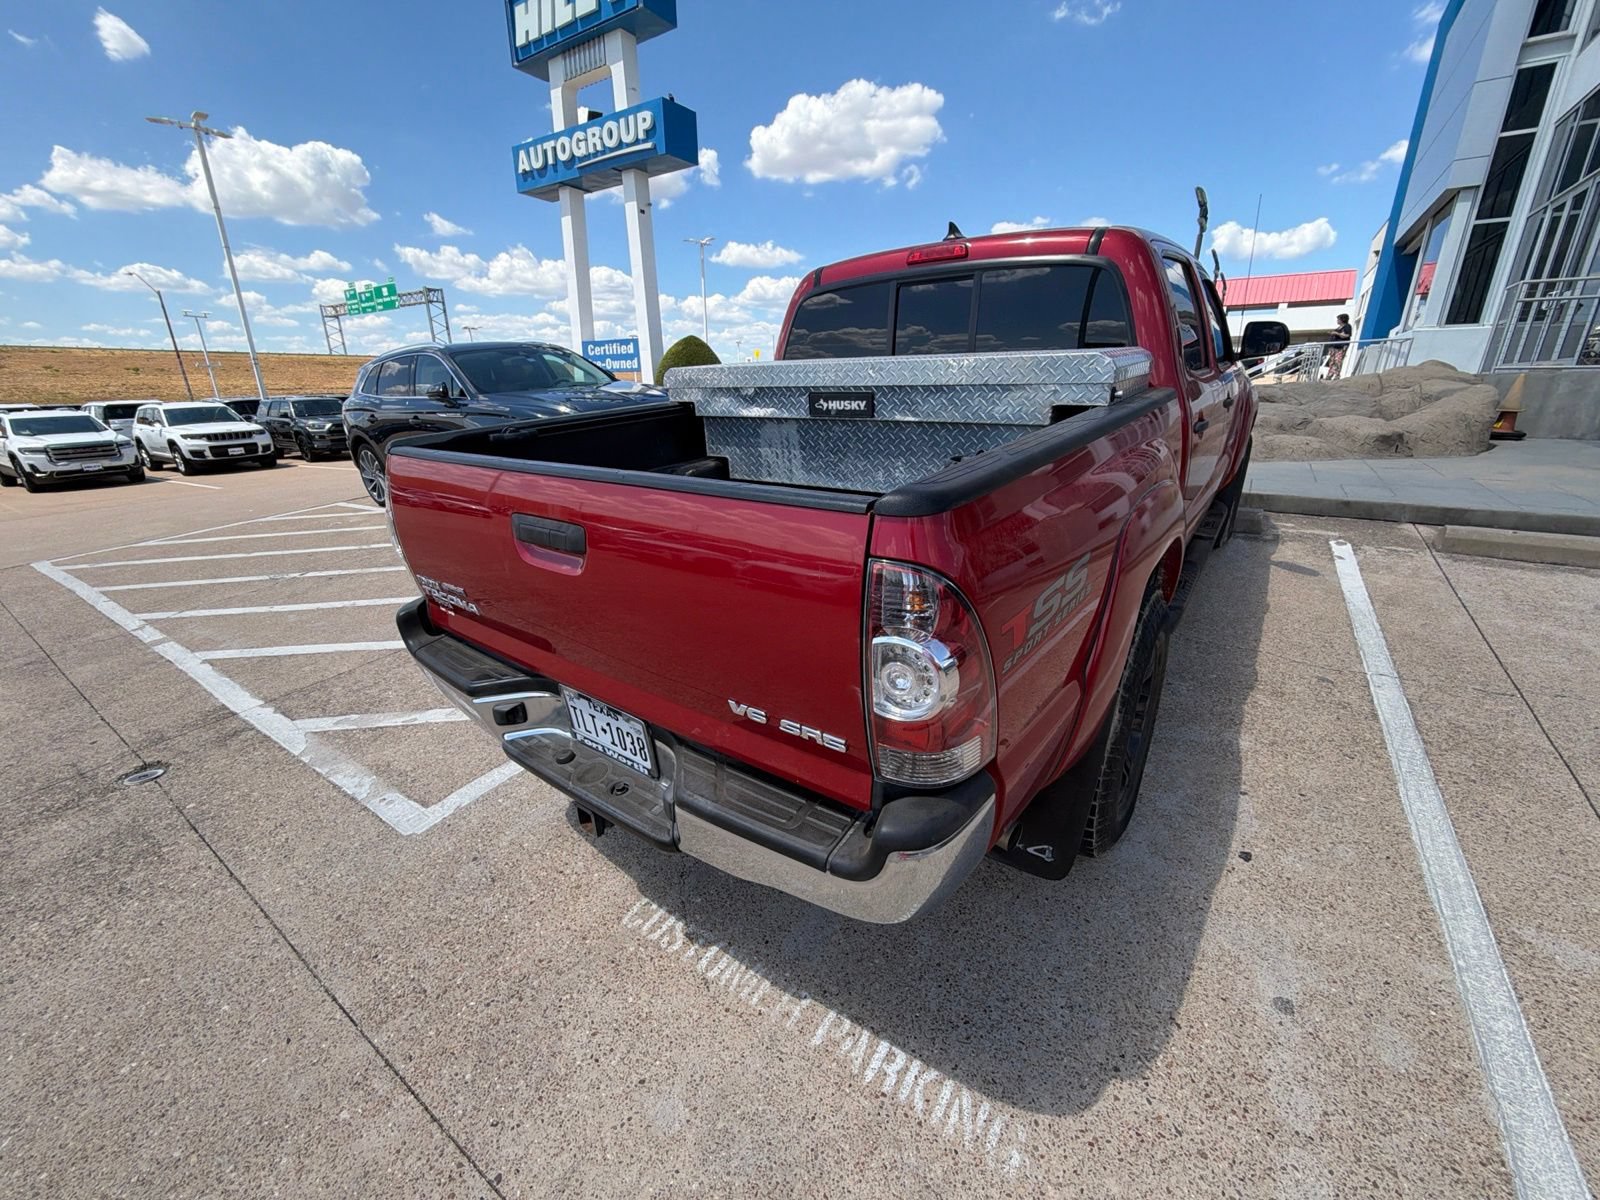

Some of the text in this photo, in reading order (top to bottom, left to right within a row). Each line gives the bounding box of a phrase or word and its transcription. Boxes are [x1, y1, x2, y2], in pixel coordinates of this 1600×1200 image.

[518, 111, 655, 173] AUTOGROUP
[588, 342, 634, 356] Certified
[828, 400, 867, 411] HUSKY
[1002, 622, 1052, 674] SPORT
[588, 700, 620, 722] TEXAS
[727, 698, 849, 754] V6 SR5
[576, 732, 650, 776] Fort Worth
